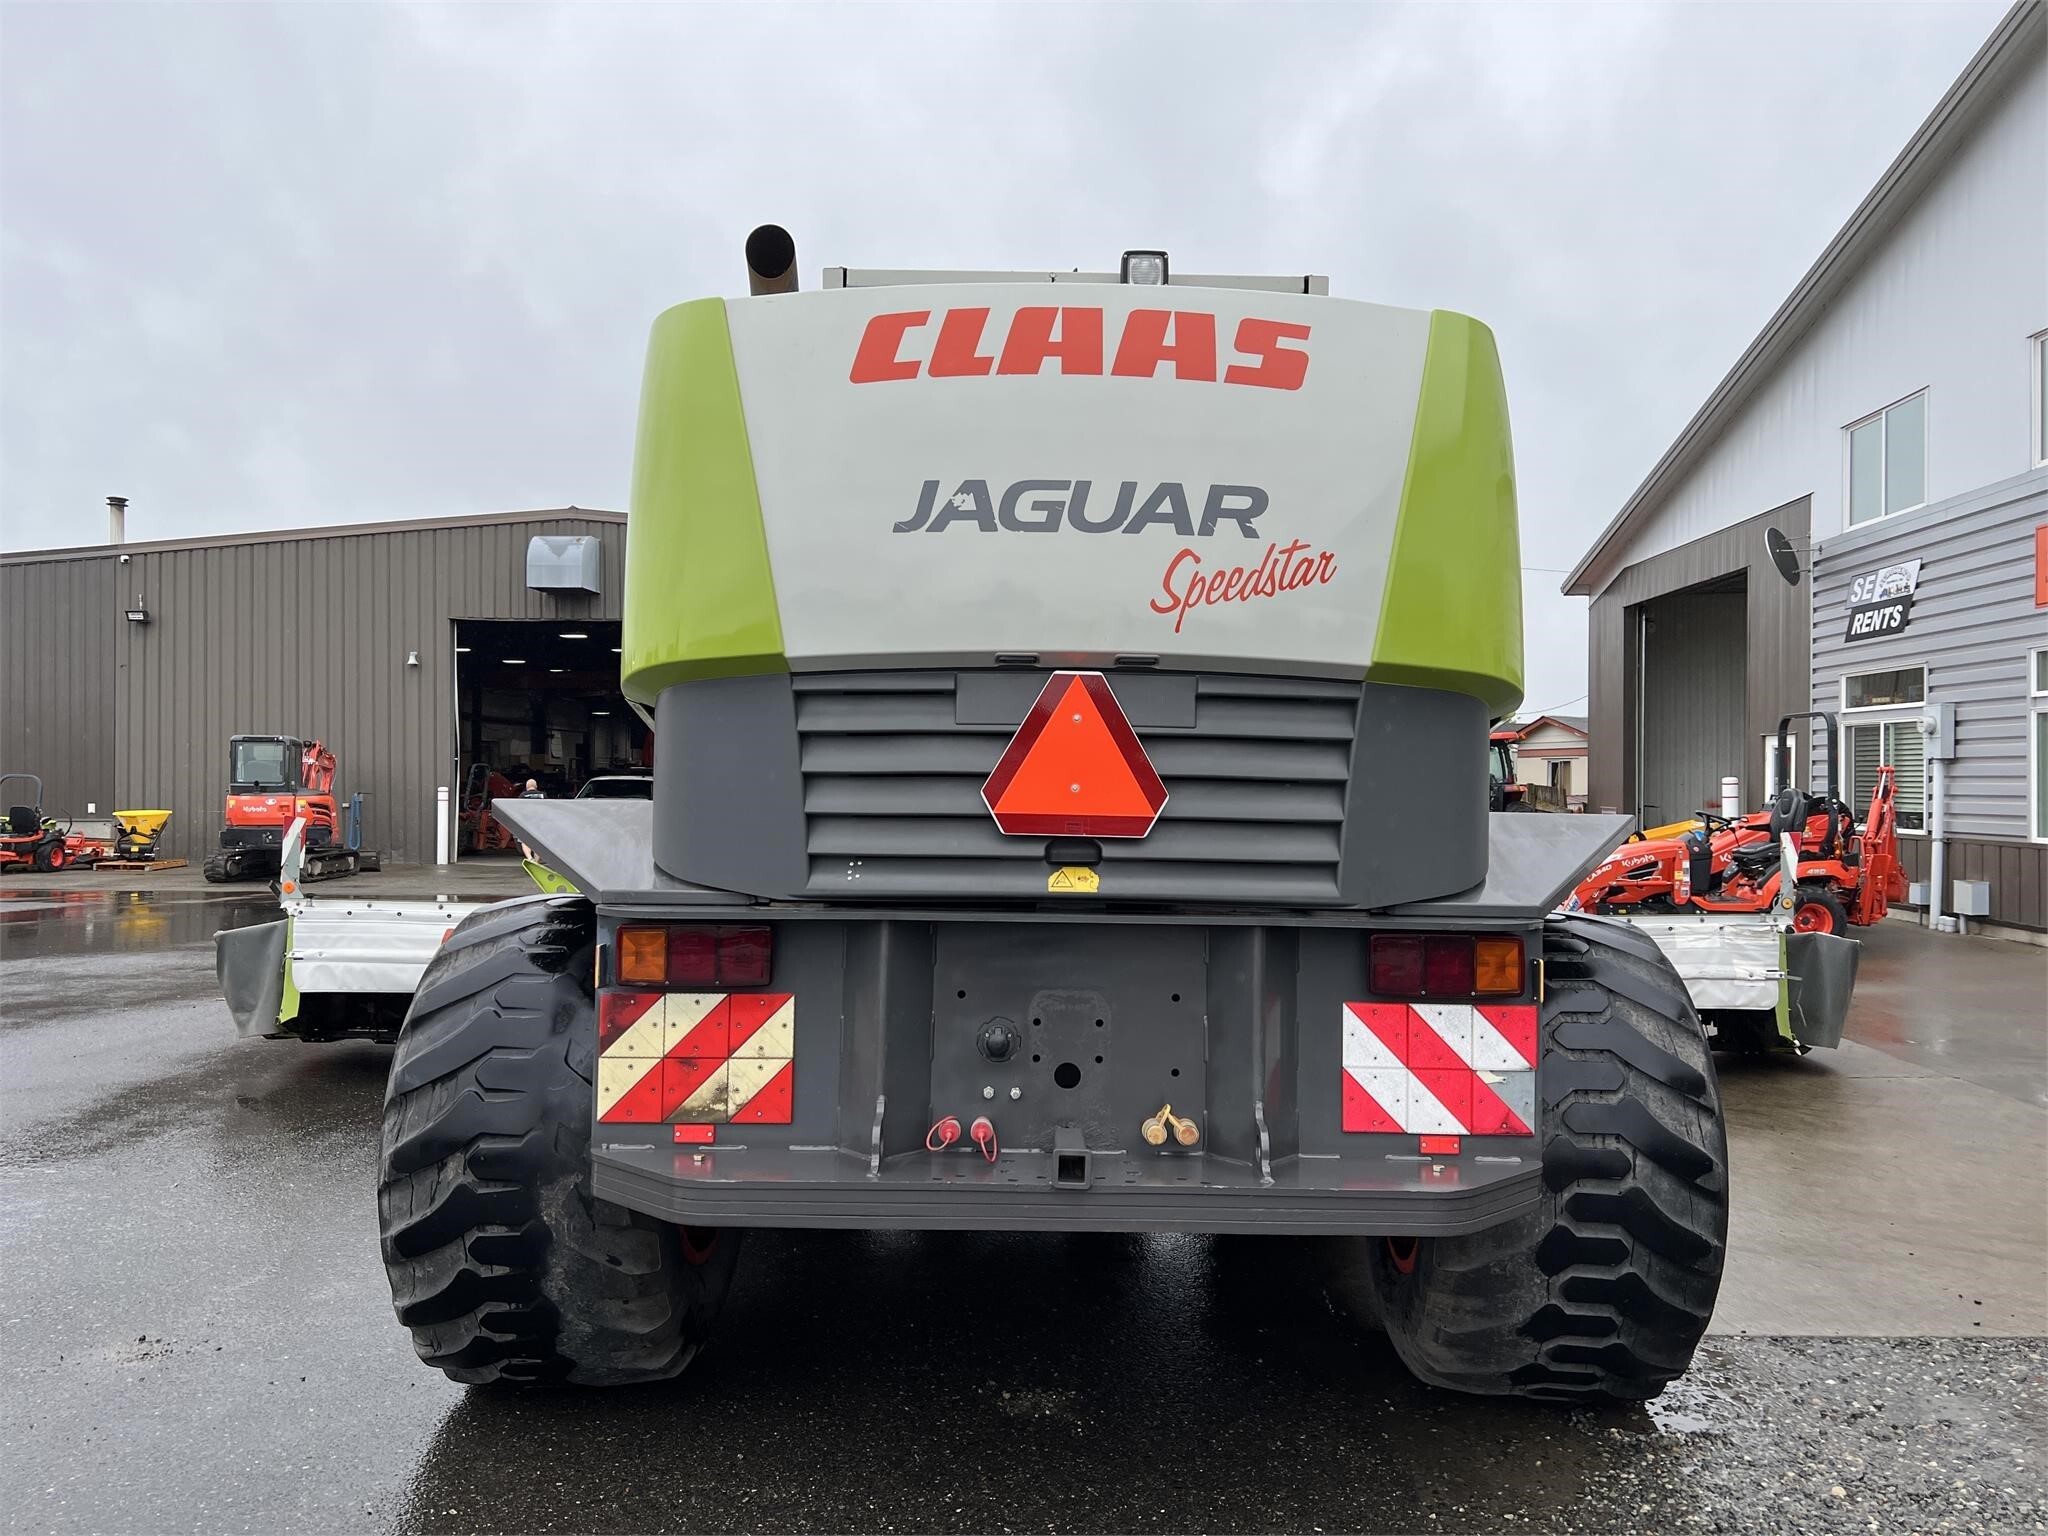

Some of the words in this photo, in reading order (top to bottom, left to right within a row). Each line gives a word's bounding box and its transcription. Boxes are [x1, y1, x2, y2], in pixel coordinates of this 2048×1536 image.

[849, 307, 1311, 391] CLAAS
[893, 480, 1269, 538] JAGUAR
[1150, 539, 1337, 633] Speedstar
[1851, 575, 1877, 602] SE
[1850, 605, 1903, 635] RENTS
[1586, 864, 1612, 882] LA340
[1621, 854, 1655, 867] Kubota
